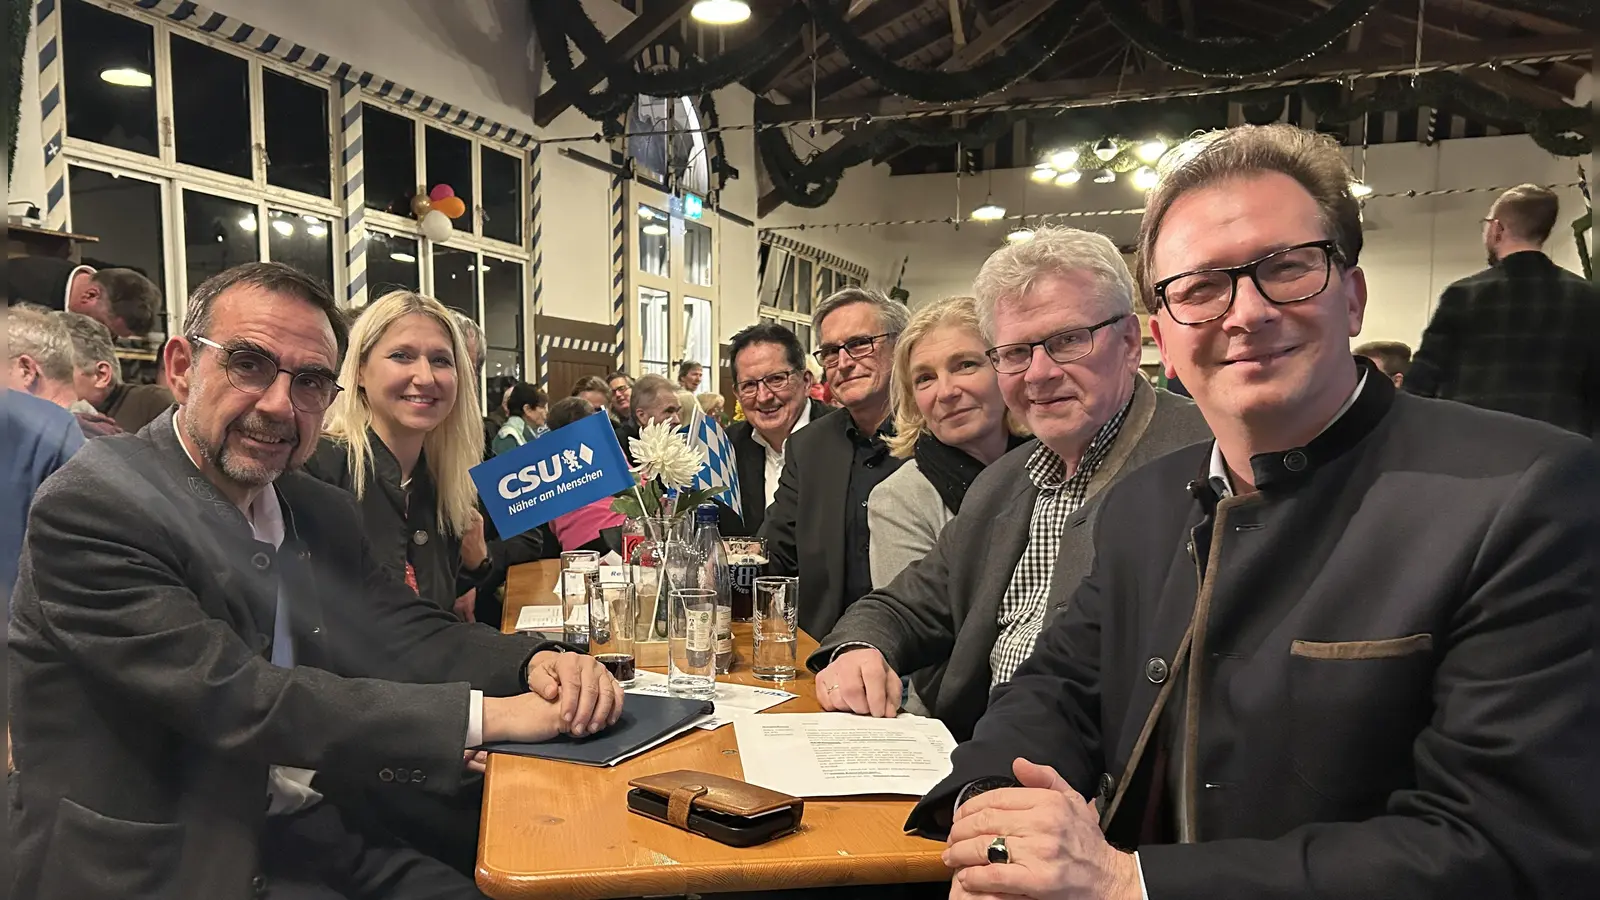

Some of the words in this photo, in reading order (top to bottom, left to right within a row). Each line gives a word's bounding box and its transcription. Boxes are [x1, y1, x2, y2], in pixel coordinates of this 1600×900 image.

[498, 454, 562, 499] CSU
[508, 496, 537, 515] Näher
[540, 490, 555, 502] am
[556, 469, 603, 495] Menschen
